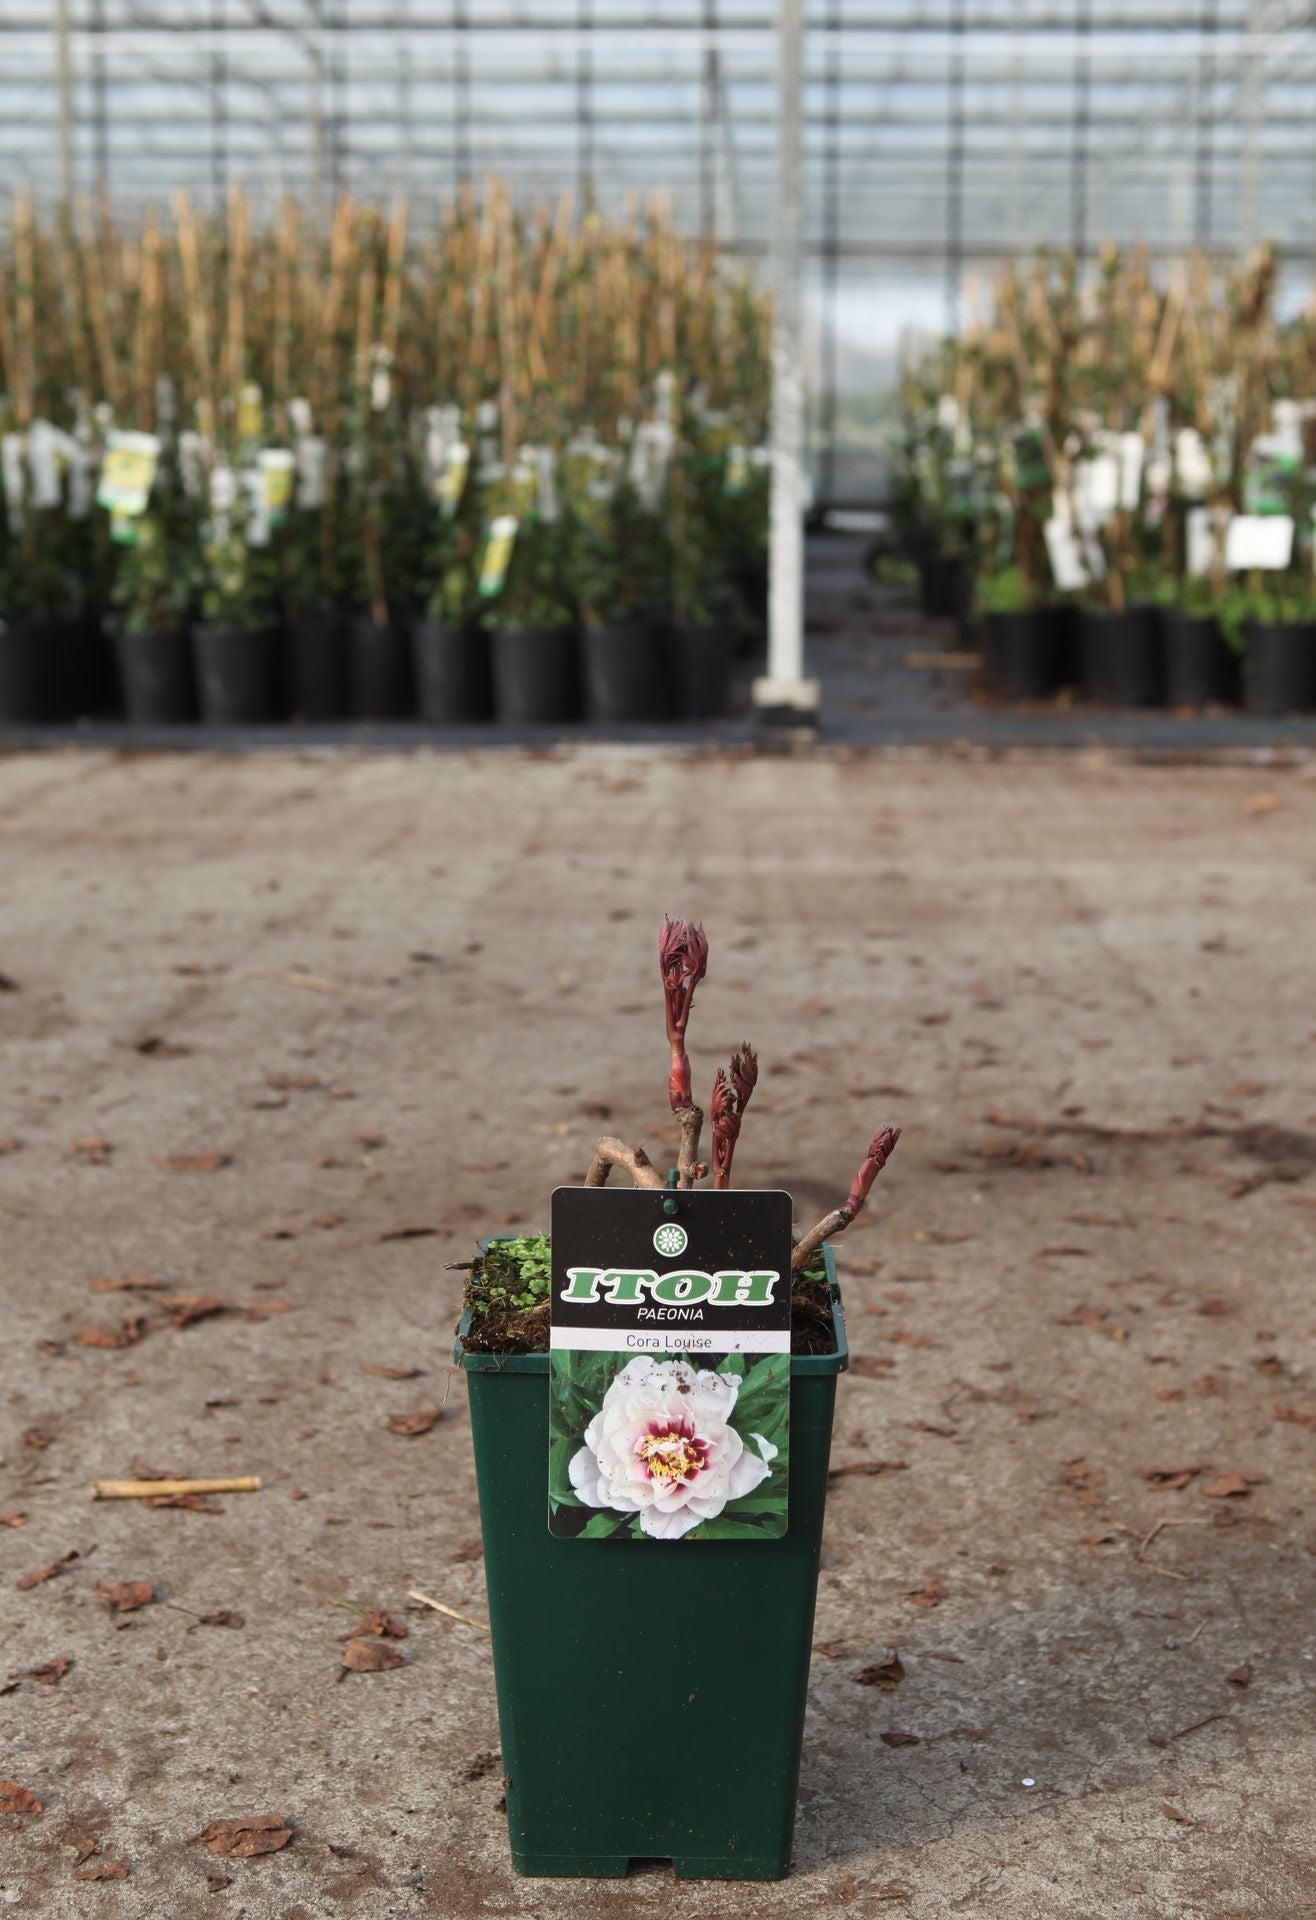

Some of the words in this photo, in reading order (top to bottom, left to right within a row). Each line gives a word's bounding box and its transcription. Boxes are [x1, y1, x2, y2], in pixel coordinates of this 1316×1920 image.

[561, 1268, 780, 1306] ITOH
[637, 1307, 704, 1320] PAEONIA
[626, 1334, 660, 1348] Cora
[665, 1335, 712, 1348] Louise
